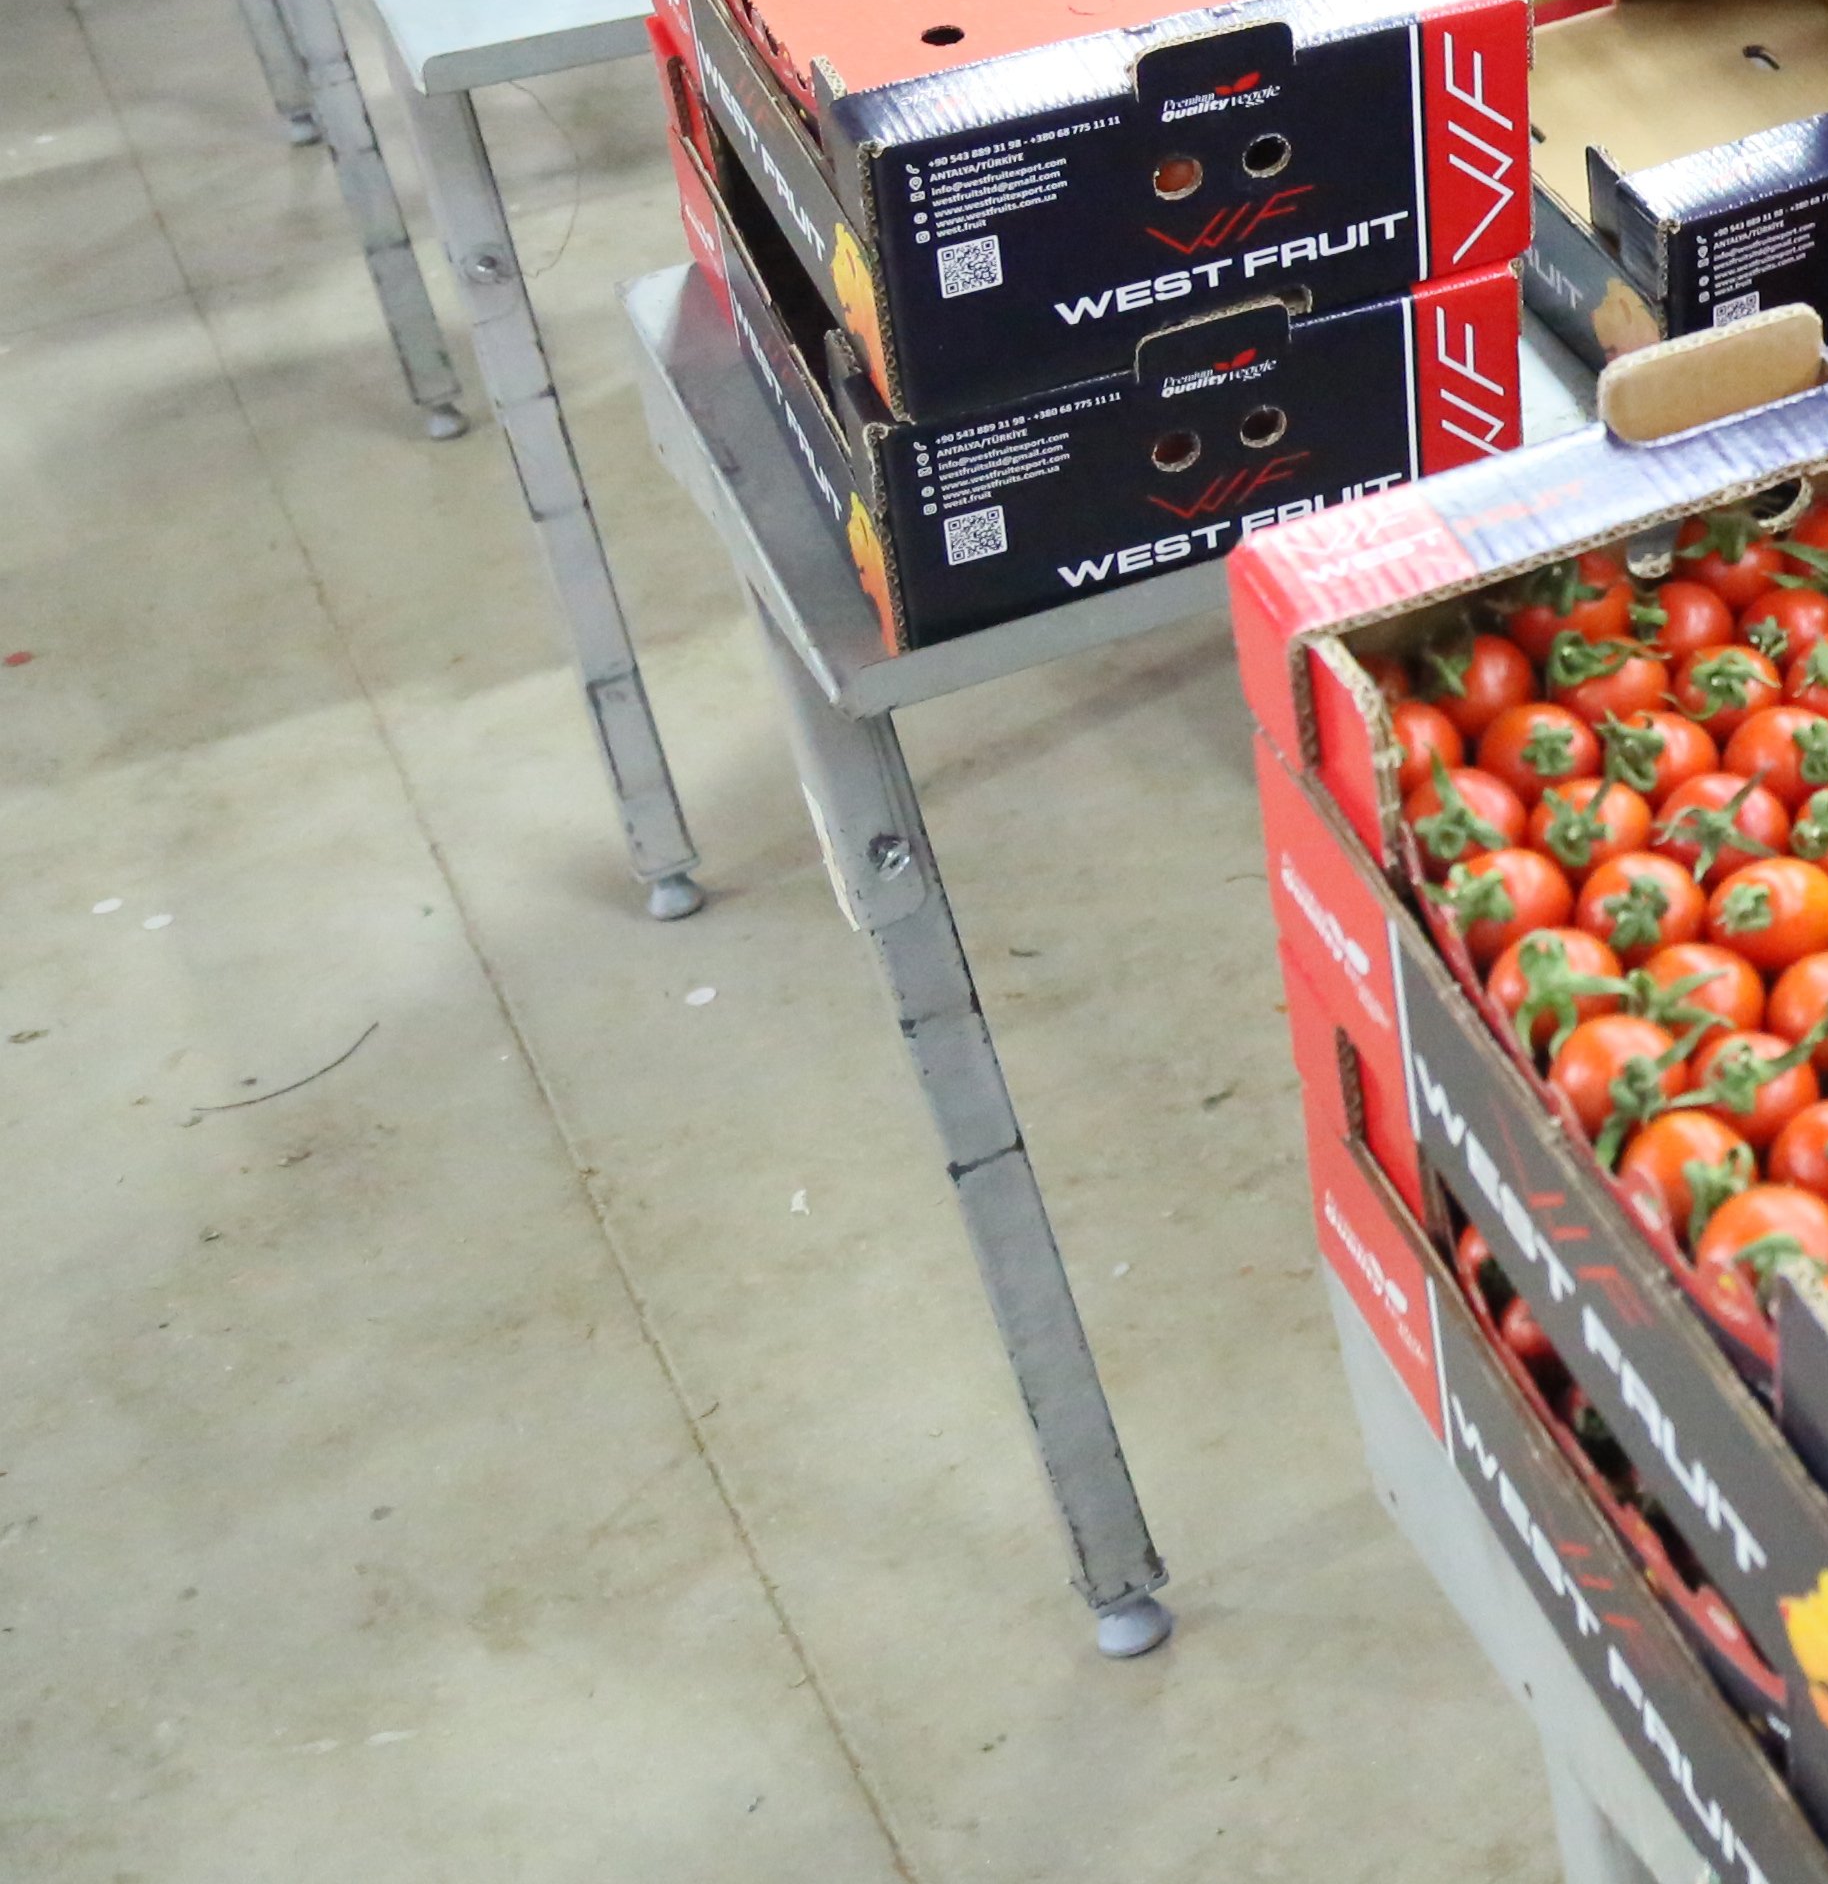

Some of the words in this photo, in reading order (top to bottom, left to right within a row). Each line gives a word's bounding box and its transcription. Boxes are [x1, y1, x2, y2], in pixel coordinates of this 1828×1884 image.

[698, 40, 758, 153] WEST
[762, 145, 826, 262] FRUIT
[1161, 97, 1230, 124] Quality
[1054, 258, 1233, 326] WEST
[1243, 210, 1409, 279] FRUIT
[729, 287, 784, 405] WEST
[785, 410, 843, 520] FRUIT
[1161, 373, 1228, 399] Quality
[1057, 521, 1231, 588] WEST
[1302, 527, 1443, 583] WEST
[1414, 1052, 1577, 1303] WEST
[1583, 1305, 1767, 1572] FRUIT
[1451, 1392, 1600, 1635] WEST
[1609, 1645, 1770, 1884] FRUIT
